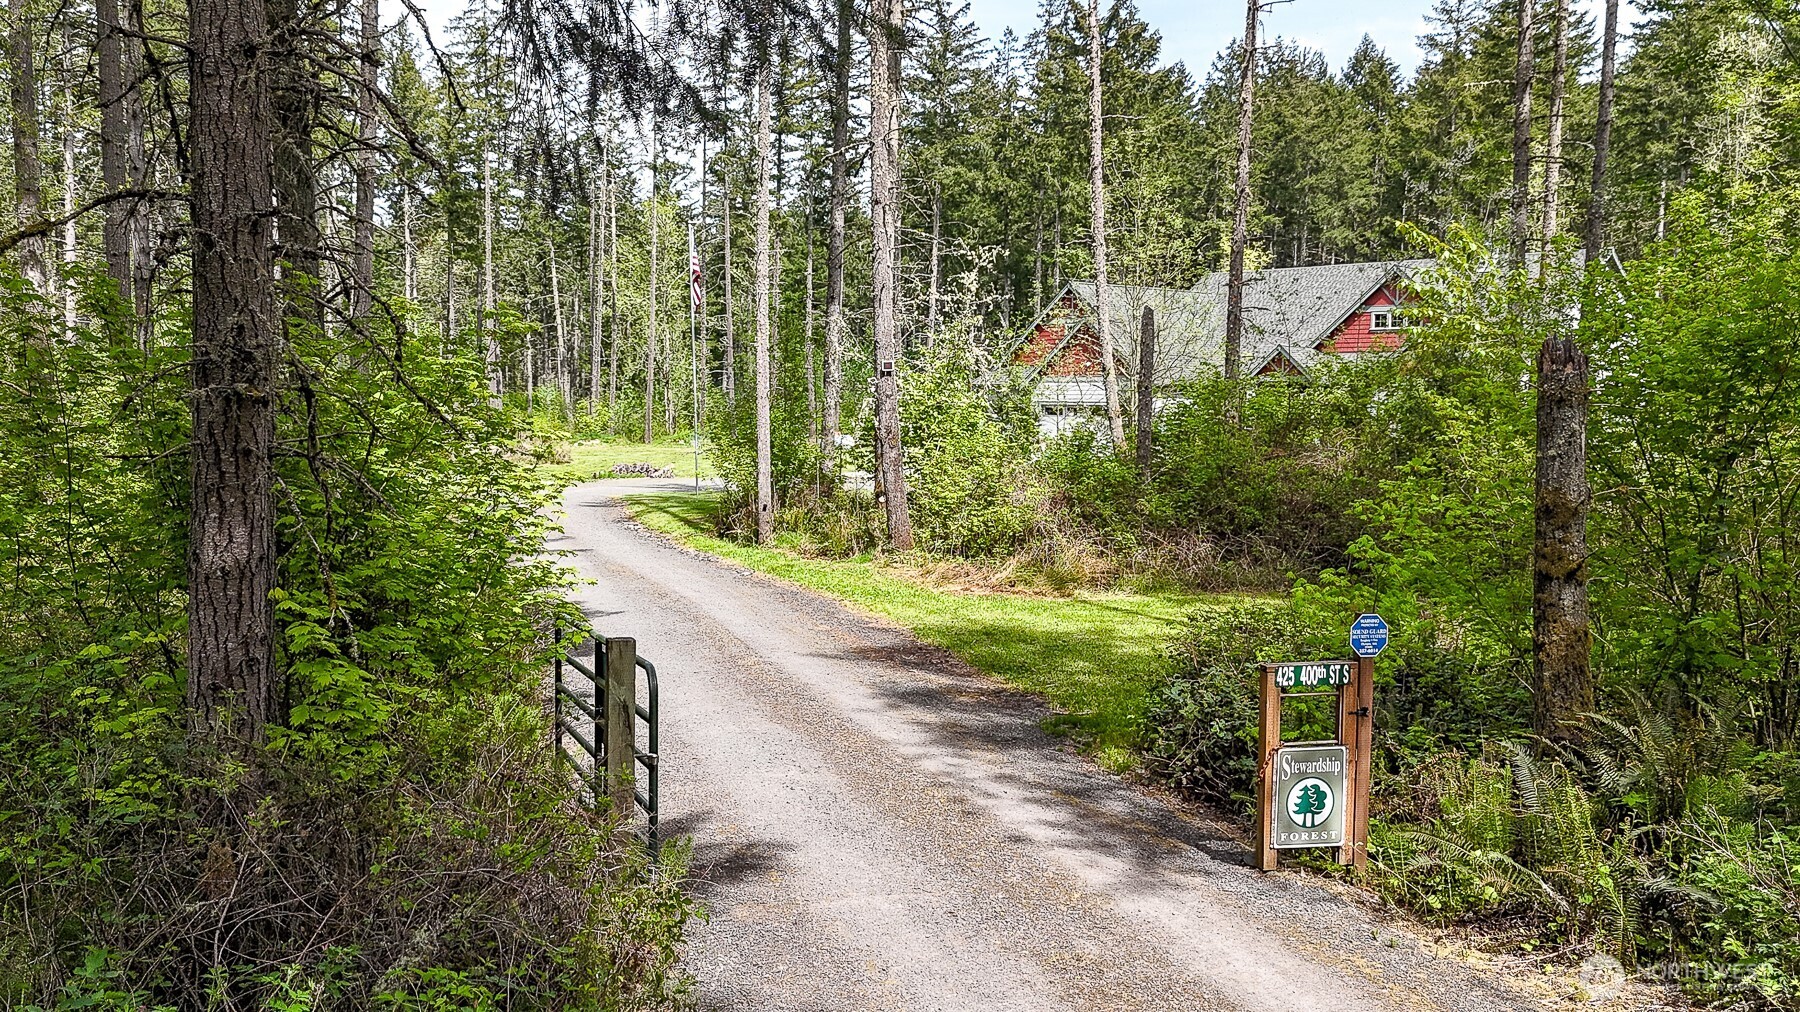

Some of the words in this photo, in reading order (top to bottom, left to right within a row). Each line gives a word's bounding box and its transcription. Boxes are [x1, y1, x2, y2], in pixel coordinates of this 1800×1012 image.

[1276, 666, 1295, 687] 425
[1300, 664, 1327, 686] 400th
[1328, 664, 1341, 685] ST
[1342, 664, 1350, 684] S
[1281, 754, 1341, 781] Stewardship
[1280, 830, 1338, 842] FOREST
